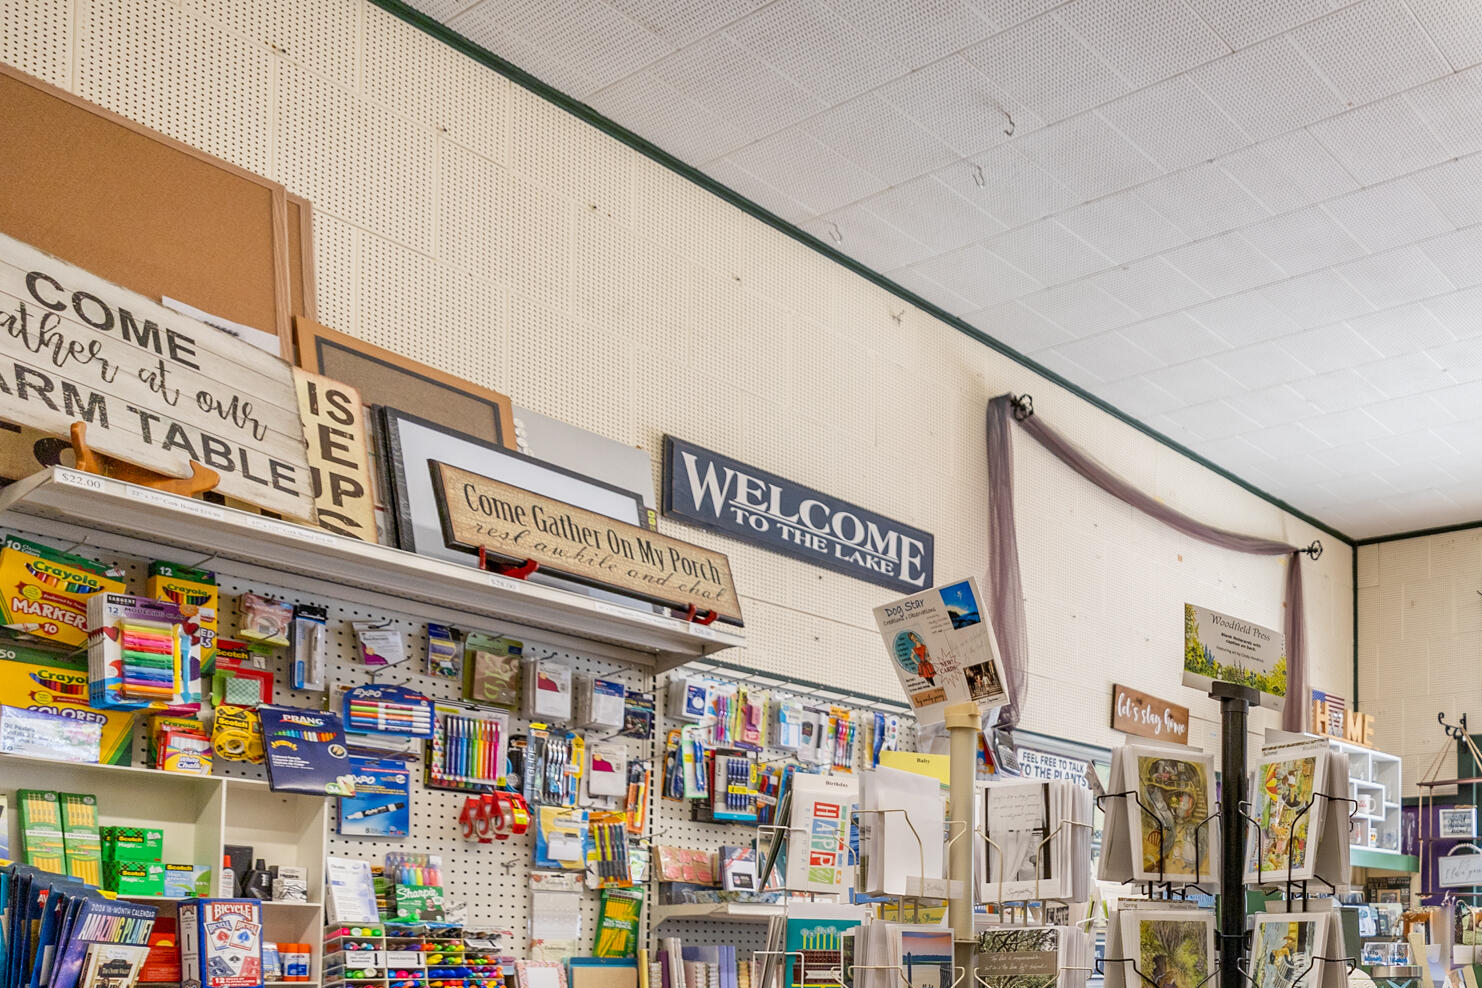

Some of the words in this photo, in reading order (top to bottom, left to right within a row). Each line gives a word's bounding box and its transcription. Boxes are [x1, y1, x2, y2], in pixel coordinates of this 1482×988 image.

[25, 271, 200, 370] COME
[138, 359, 180, 406] at
[197, 390, 268, 441] our
[127, 405, 301, 498] TABLE
[680, 451, 926, 587] WELCOME
[463, 483, 525, 528] Come
[531, 502, 602, 554] Gather
[607, 527, 631, 558] On
[638, 533, 665, 572] My
[668, 547, 721, 584] Porch
[729, 506, 770, 532] TO
[777, 523, 828, 554] THE
[834, 540, 894, 576] LAKE
[474, 520, 521, 545] rest
[533, 538, 617, 569] awhile
[628, 564, 668, 582] and
[32, 560, 98, 588] Crayola
[159, 566, 173, 576] 12
[167, 583, 209, 597] Crayola
[885, 605, 903, 618] Dog
[905, 599, 925, 612] Star
[43, 623, 58, 635] 10
[1210, 613, 1251, 634] Woodfield
[1253, 628, 1271, 641] Press
[216, 648, 249, 661] Scotch
[217, 718, 248, 729] Scotch
[283, 714, 324, 727] PRANG
[1117, 694, 1139, 722] let's
[1141, 704, 1163, 735] stay
[1164, 712, 1186, 733] home
[1019, 763, 1031, 776] TO
[1034, 766, 1051, 779] THE
[1023, 752, 1038, 764] FEEL
[1040, 754, 1057, 767] FREE
[1058, 759, 1067, 769] TO
[1069, 761, 1084, 773] TALK
[118, 836, 144, 845] Scotch
[120, 870, 146, 878] Scotch
[396, 887, 439, 900] Sharpie
[131, 908, 155, 918] CALENDAR
[214, 903, 251, 917] BICYCLE
[78, 914, 126, 942] AMAZING
